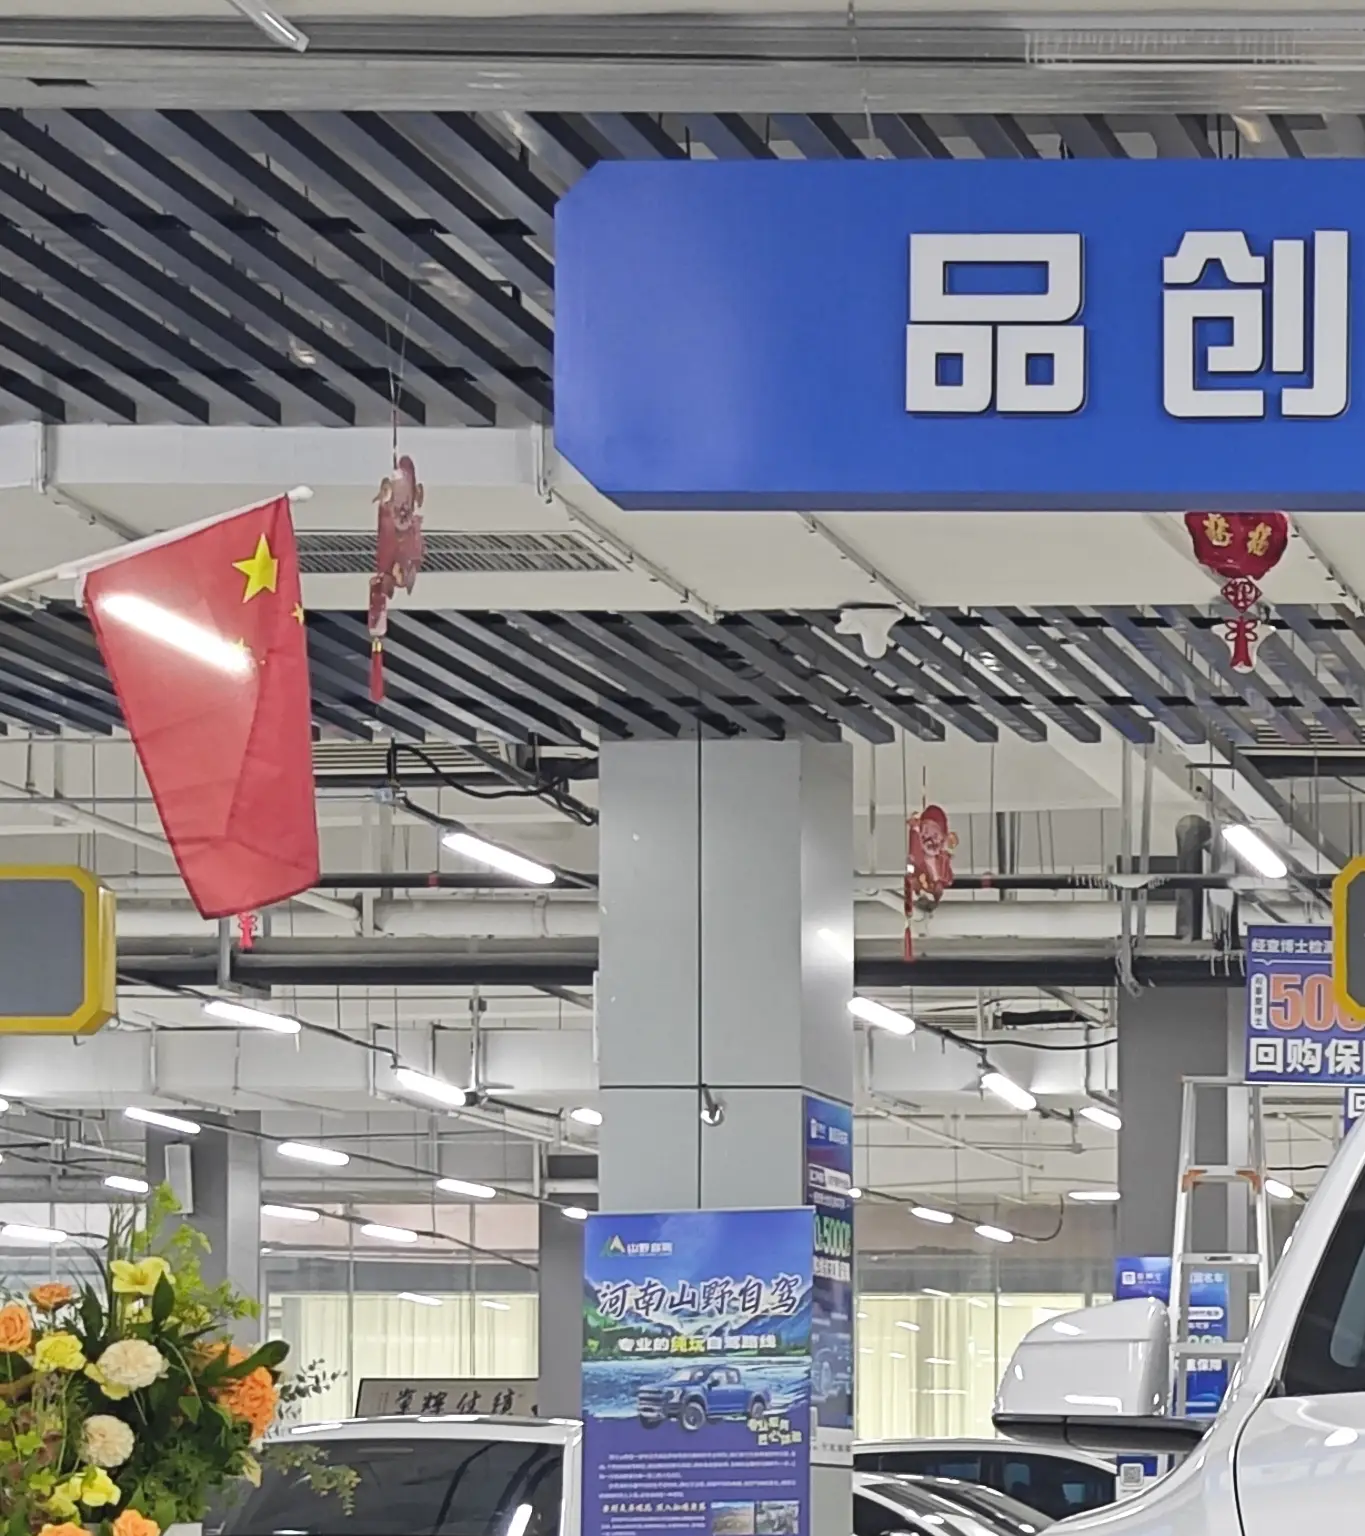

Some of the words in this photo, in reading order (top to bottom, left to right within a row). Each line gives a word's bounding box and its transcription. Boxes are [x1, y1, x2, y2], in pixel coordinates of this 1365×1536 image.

[905, 229, 1350, 419] 品创
[597, 1272, 802, 1322] 河南山野自驾
